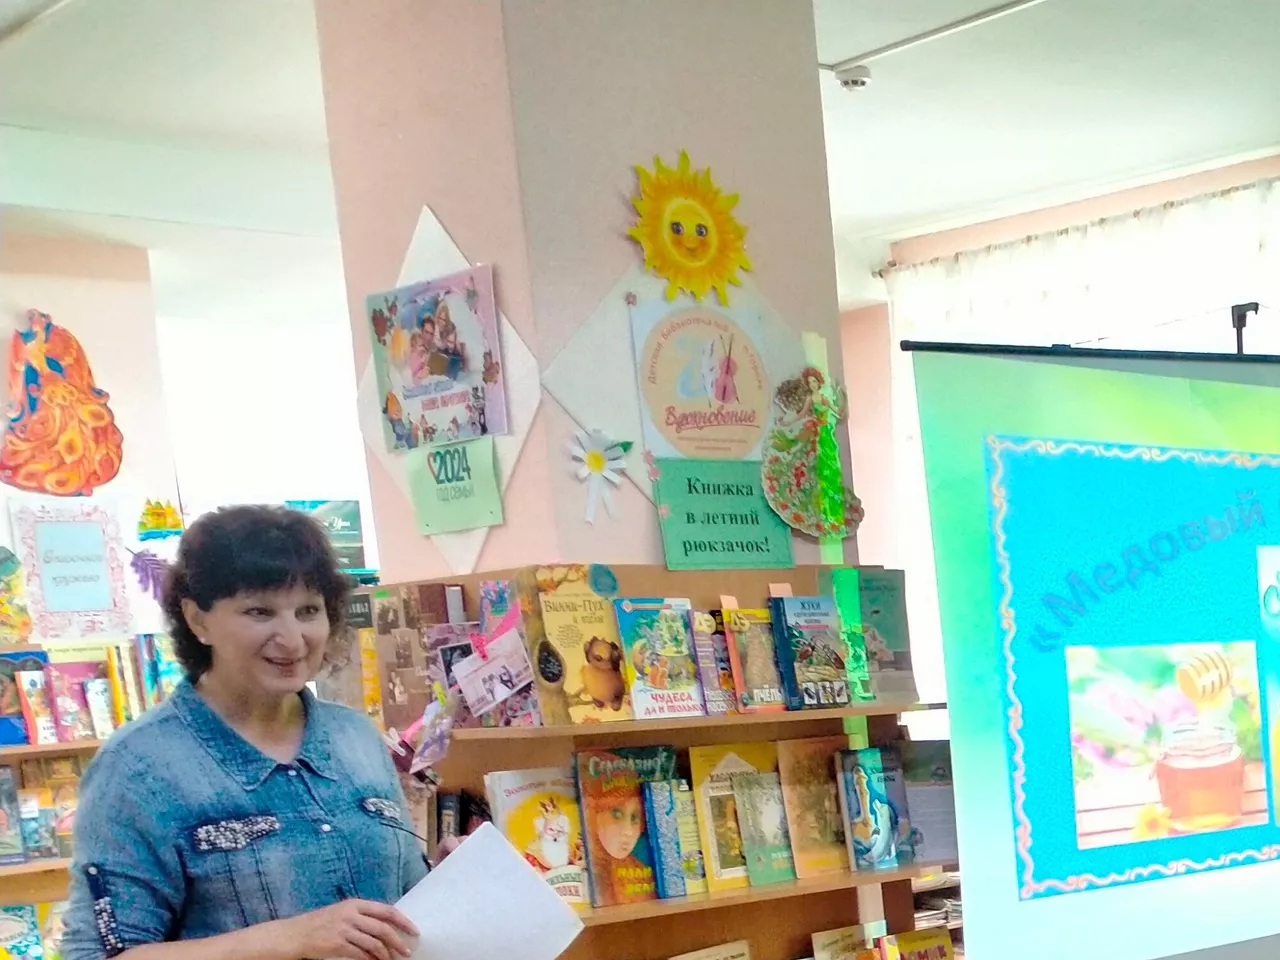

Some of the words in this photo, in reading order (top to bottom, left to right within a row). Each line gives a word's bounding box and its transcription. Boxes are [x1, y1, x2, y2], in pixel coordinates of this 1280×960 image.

[664, 405, 757, 434] Вдохновение
[686, 476, 754, 497] Книжка
[686, 512, 696, 525] в
[700, 506, 760, 526] летний
[681, 535, 771, 557] рюкзачок!
